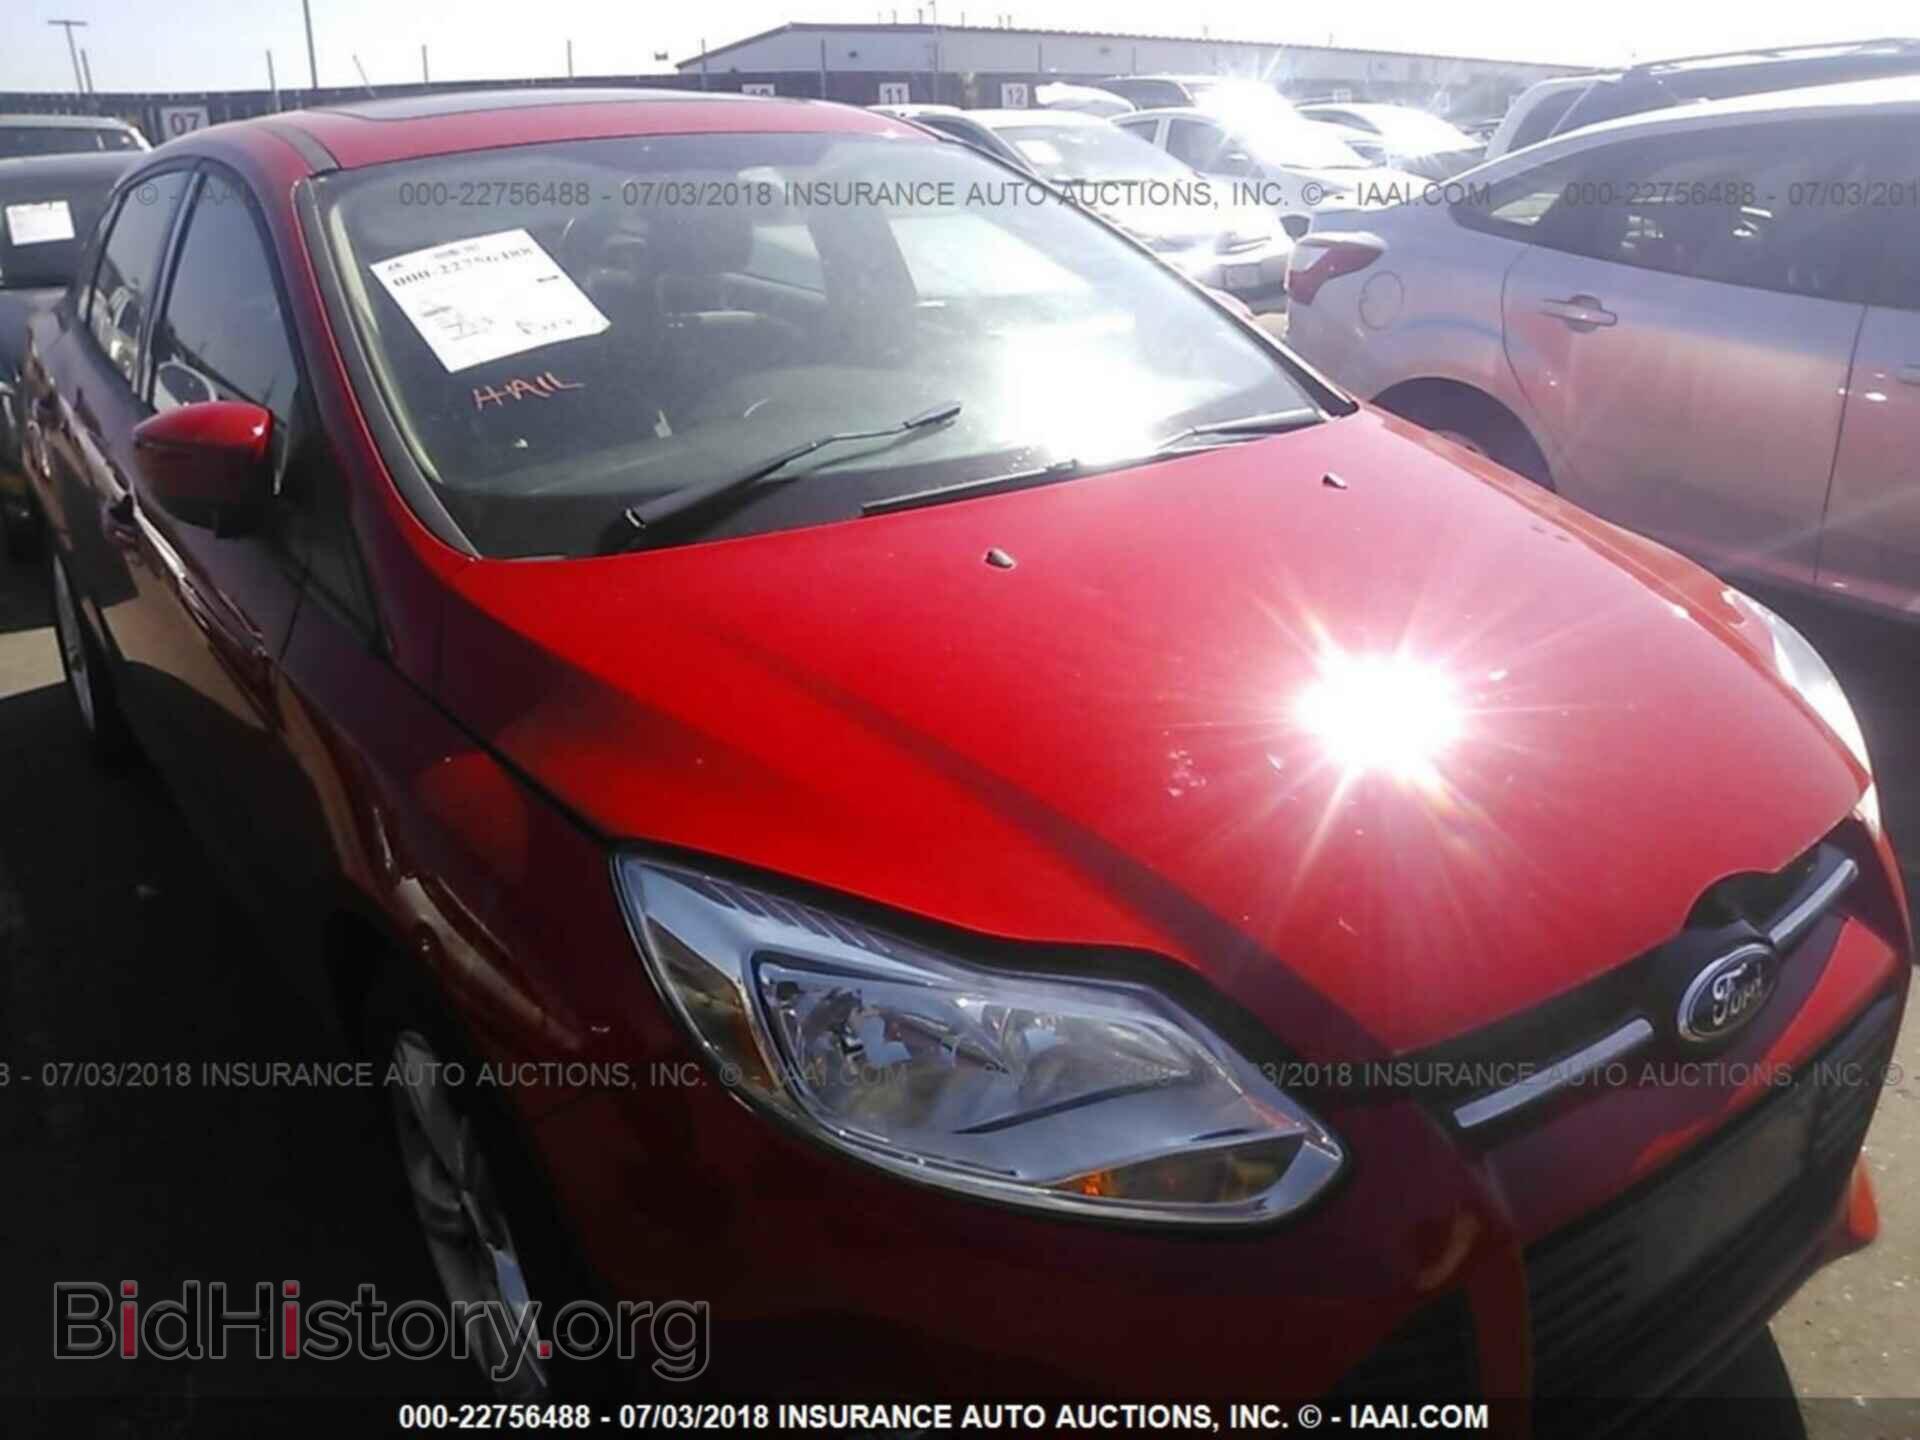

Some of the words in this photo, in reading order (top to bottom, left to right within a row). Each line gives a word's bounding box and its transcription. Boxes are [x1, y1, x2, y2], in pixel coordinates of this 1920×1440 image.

[170, 111, 200, 136] 07
[471, 371, 585, 411] HAIL
[1712, 962, 1762, 1026] Ford
